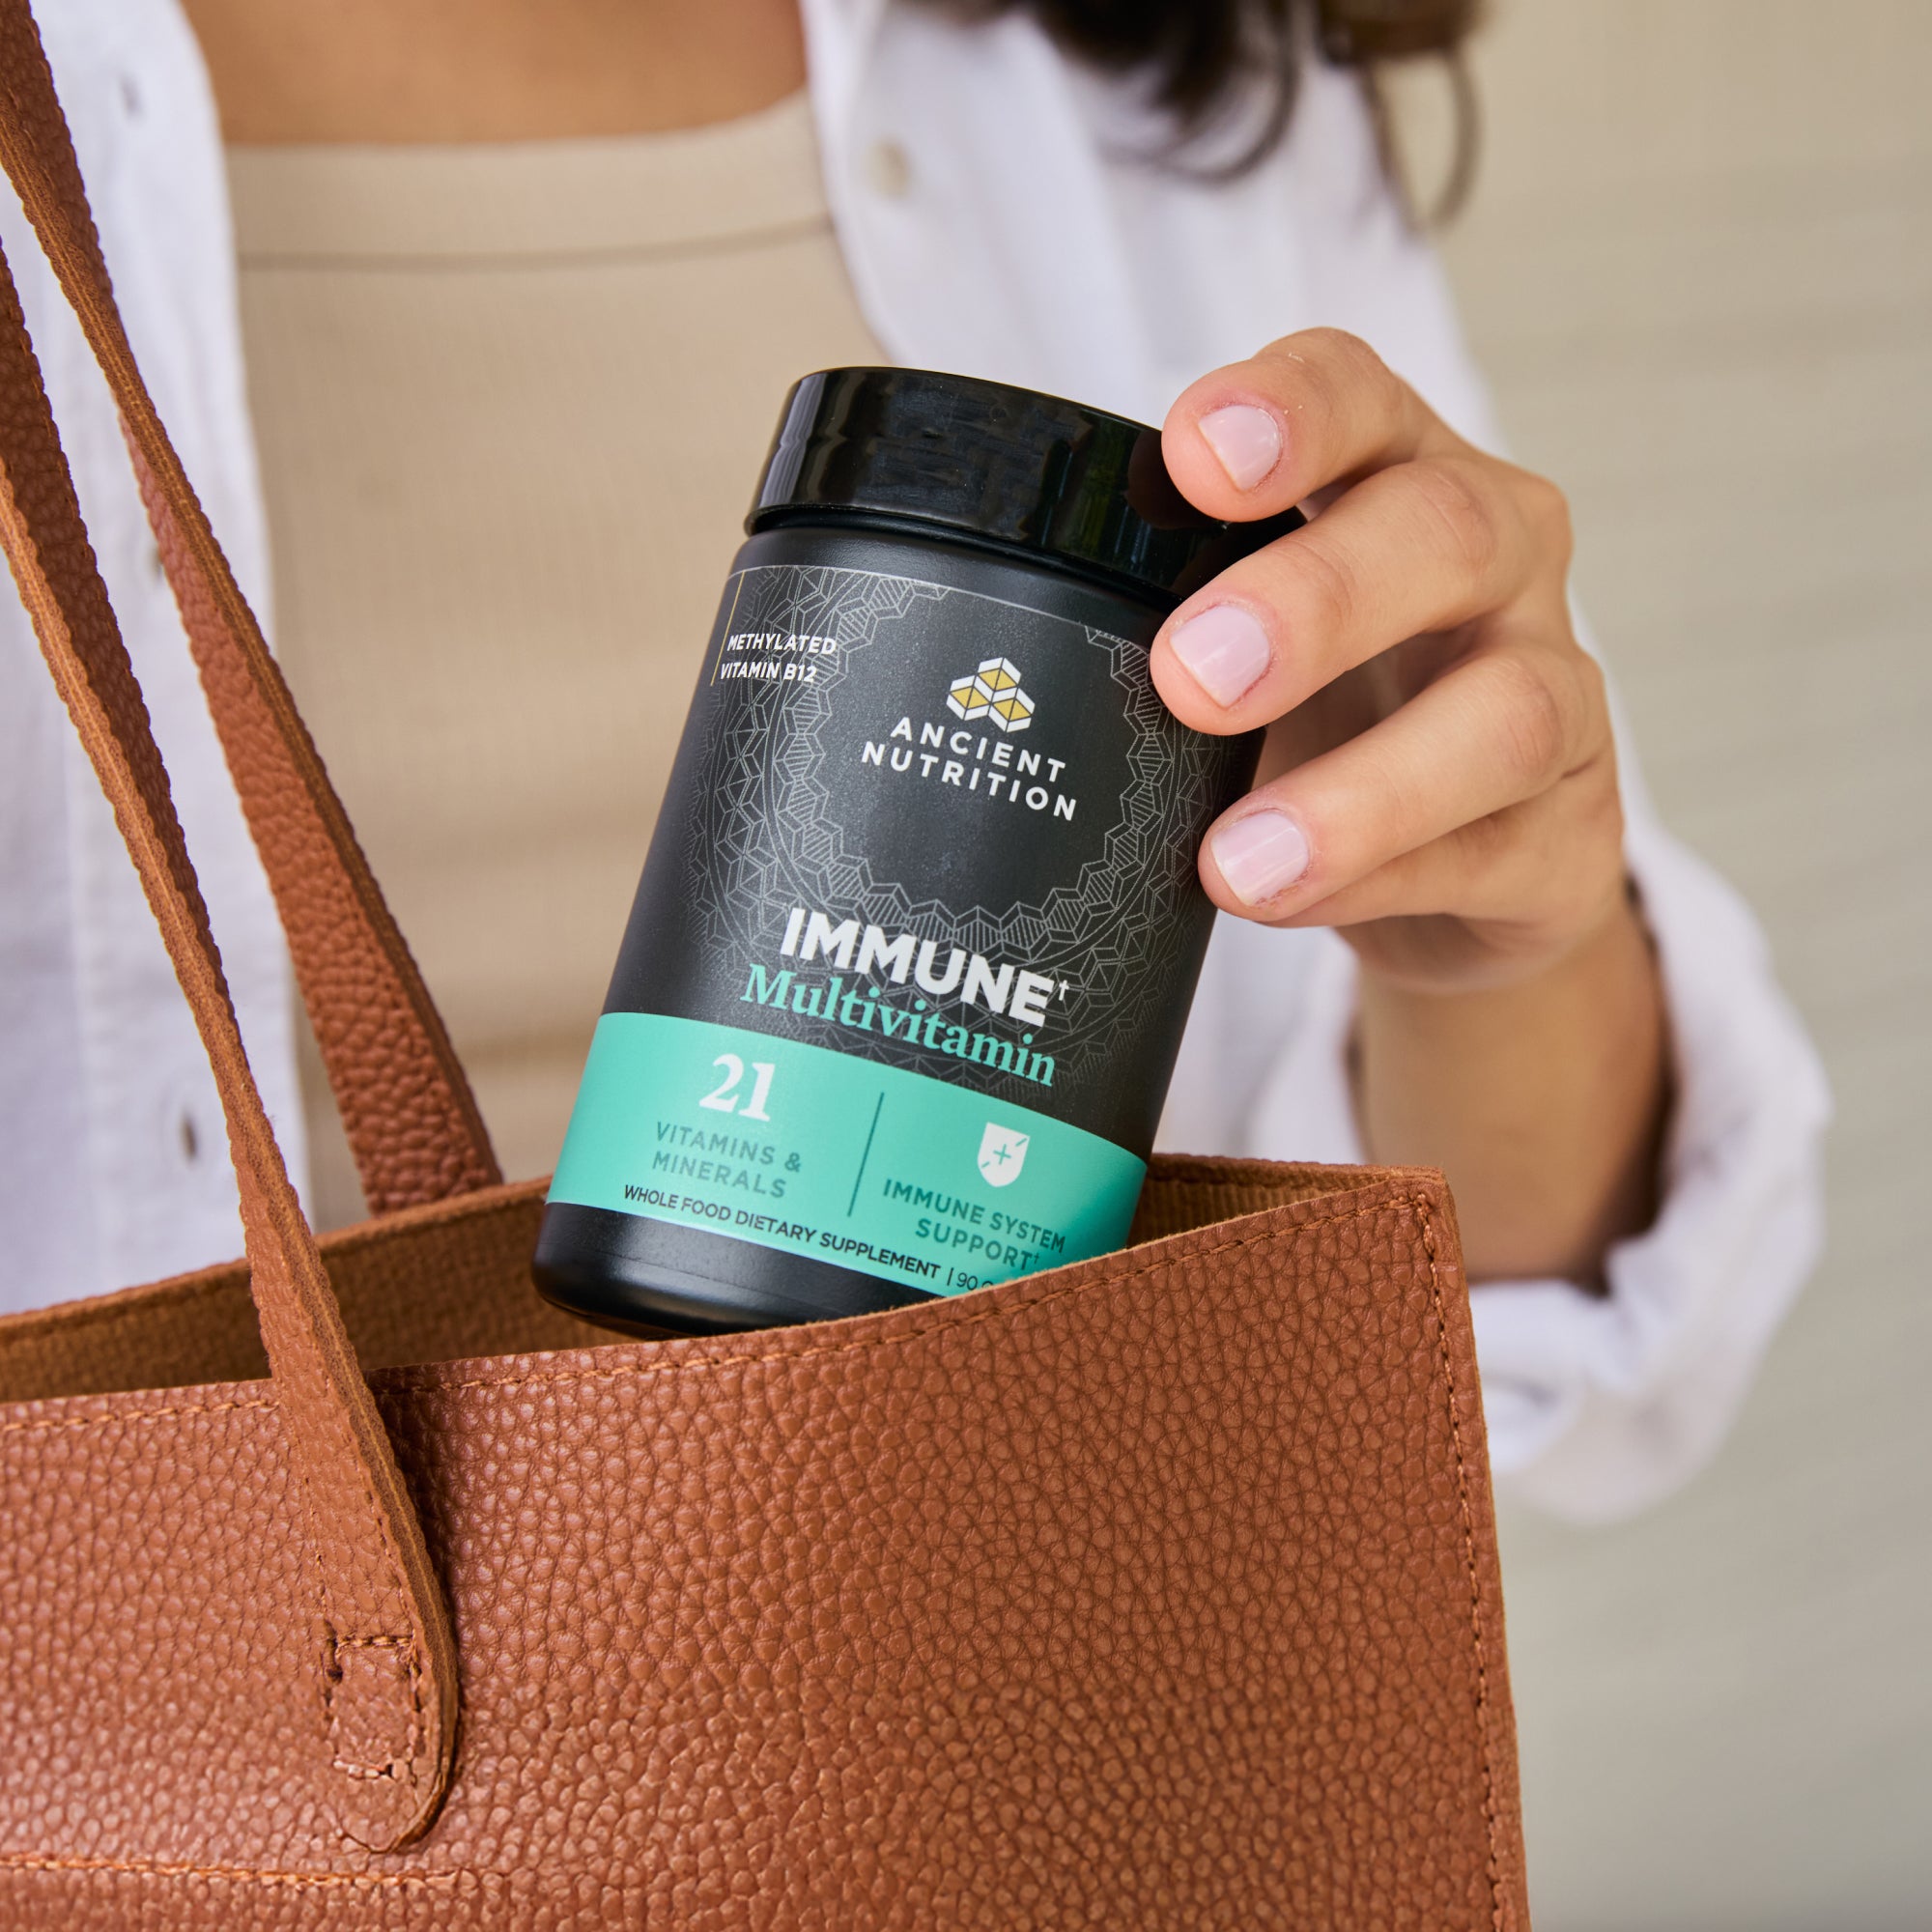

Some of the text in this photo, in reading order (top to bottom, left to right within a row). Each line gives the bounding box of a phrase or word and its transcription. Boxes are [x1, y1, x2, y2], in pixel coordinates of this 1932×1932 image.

[720, 661, 817, 683] VITAMIN B12
[726, 633, 837, 655] METHYLATED
[861, 741, 1076, 821] NUTRITION
[890, 716, 1065, 783] ANCIENT
[739, 963, 1056, 1087] Multivitamin
[698, 1053, 776, 1122] 21
[652, 1151, 787, 1199] MINERALS
[657, 1121, 802, 1173] VITAMINS &
[624, 1184, 679, 1209] WHOLE
[680, 1197, 731, 1222] FOOD
[734, 1210, 817, 1242] DIETARY
[819, 1233, 942, 1279] SUPPLEMENT
[956, 1272, 979, 1292] 90
[883, 1179, 1066, 1254] IMMUNE SYSTEM
